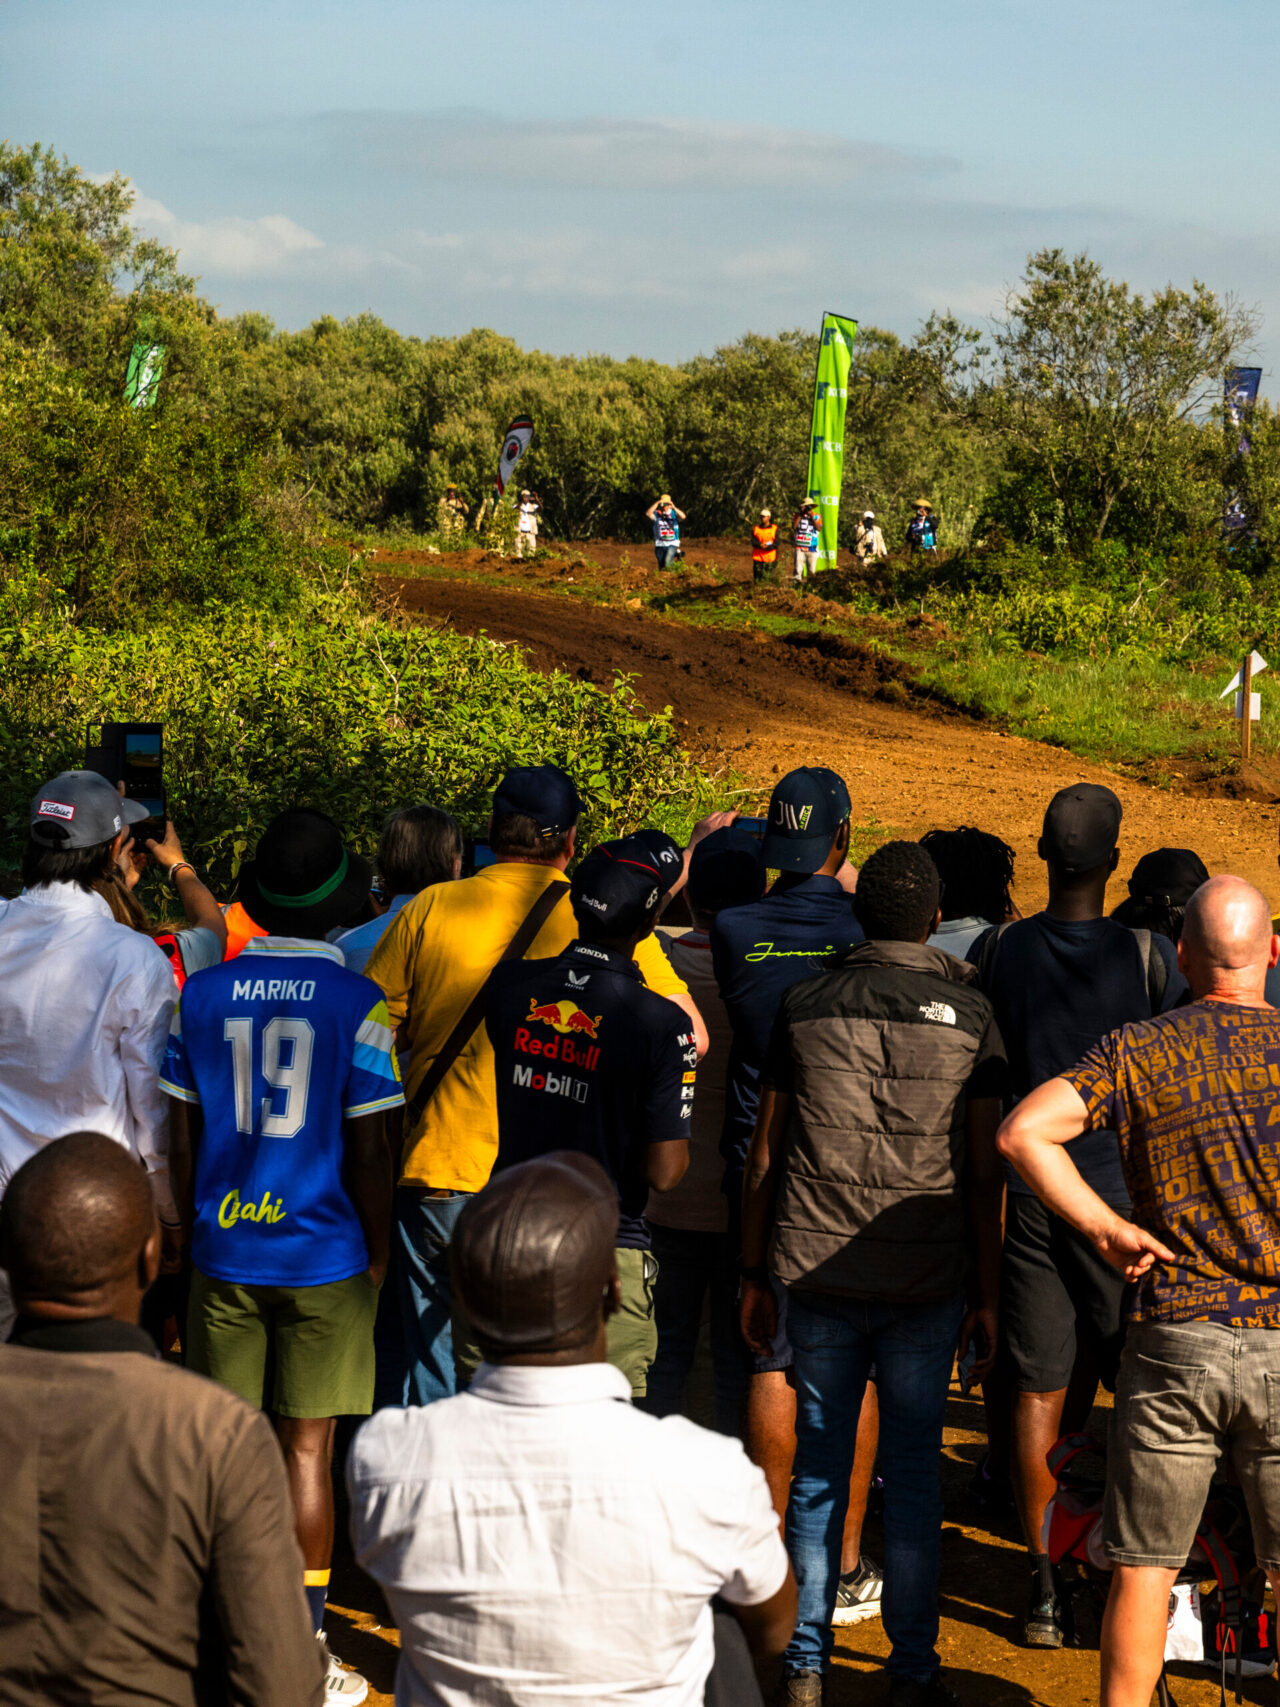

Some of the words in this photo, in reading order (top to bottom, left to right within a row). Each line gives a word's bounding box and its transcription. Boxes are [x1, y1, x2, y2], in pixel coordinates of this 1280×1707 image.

[828, 387, 847, 399] KCB
[823, 441, 841, 452] KCB
[821, 496, 838, 506] KCB
[817, 549, 835, 560] KCB
[575, 946, 610, 961] HONDA
[232, 979, 316, 1001] MARIKO
[919, 1005, 944, 1015] NORTH
[931, 1001, 945, 1009] THE
[925, 1012, 944, 1021] FACE
[514, 1028, 560, 1060] Red
[561, 1038, 600, 1071] Bull
[224, 1017, 316, 1138] 19
[513, 1064, 571, 1097] Mobil
